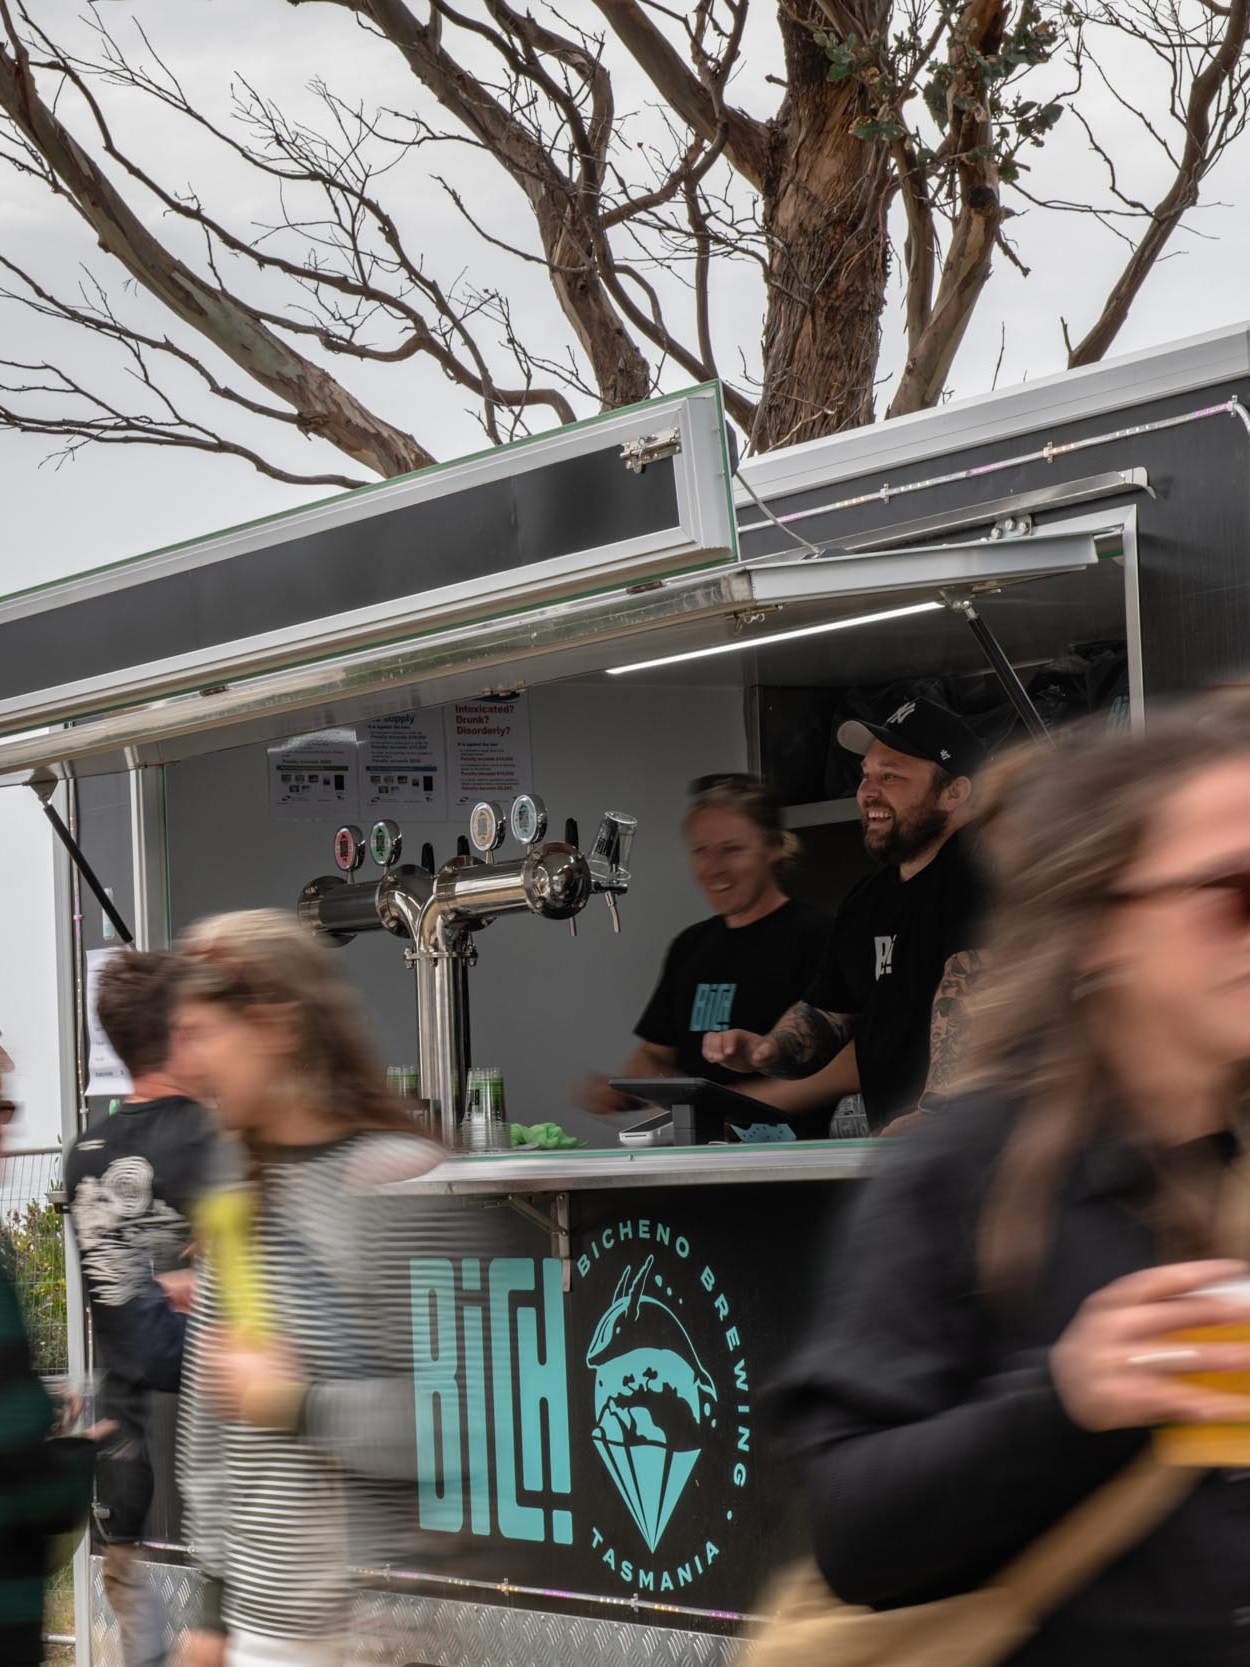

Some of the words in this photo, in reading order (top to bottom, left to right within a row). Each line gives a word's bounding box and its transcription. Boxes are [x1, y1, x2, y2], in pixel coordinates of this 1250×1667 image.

[455, 703, 515, 714] Intoxicated?
[456, 715, 490, 724] Drunk?
[456, 726, 511, 737] Disorderly?
[577, 1218, 690, 1278] BICHENO
[699, 1265, 751, 1488] BREWING
[591, 1527, 721, 1592] TASMANIA
